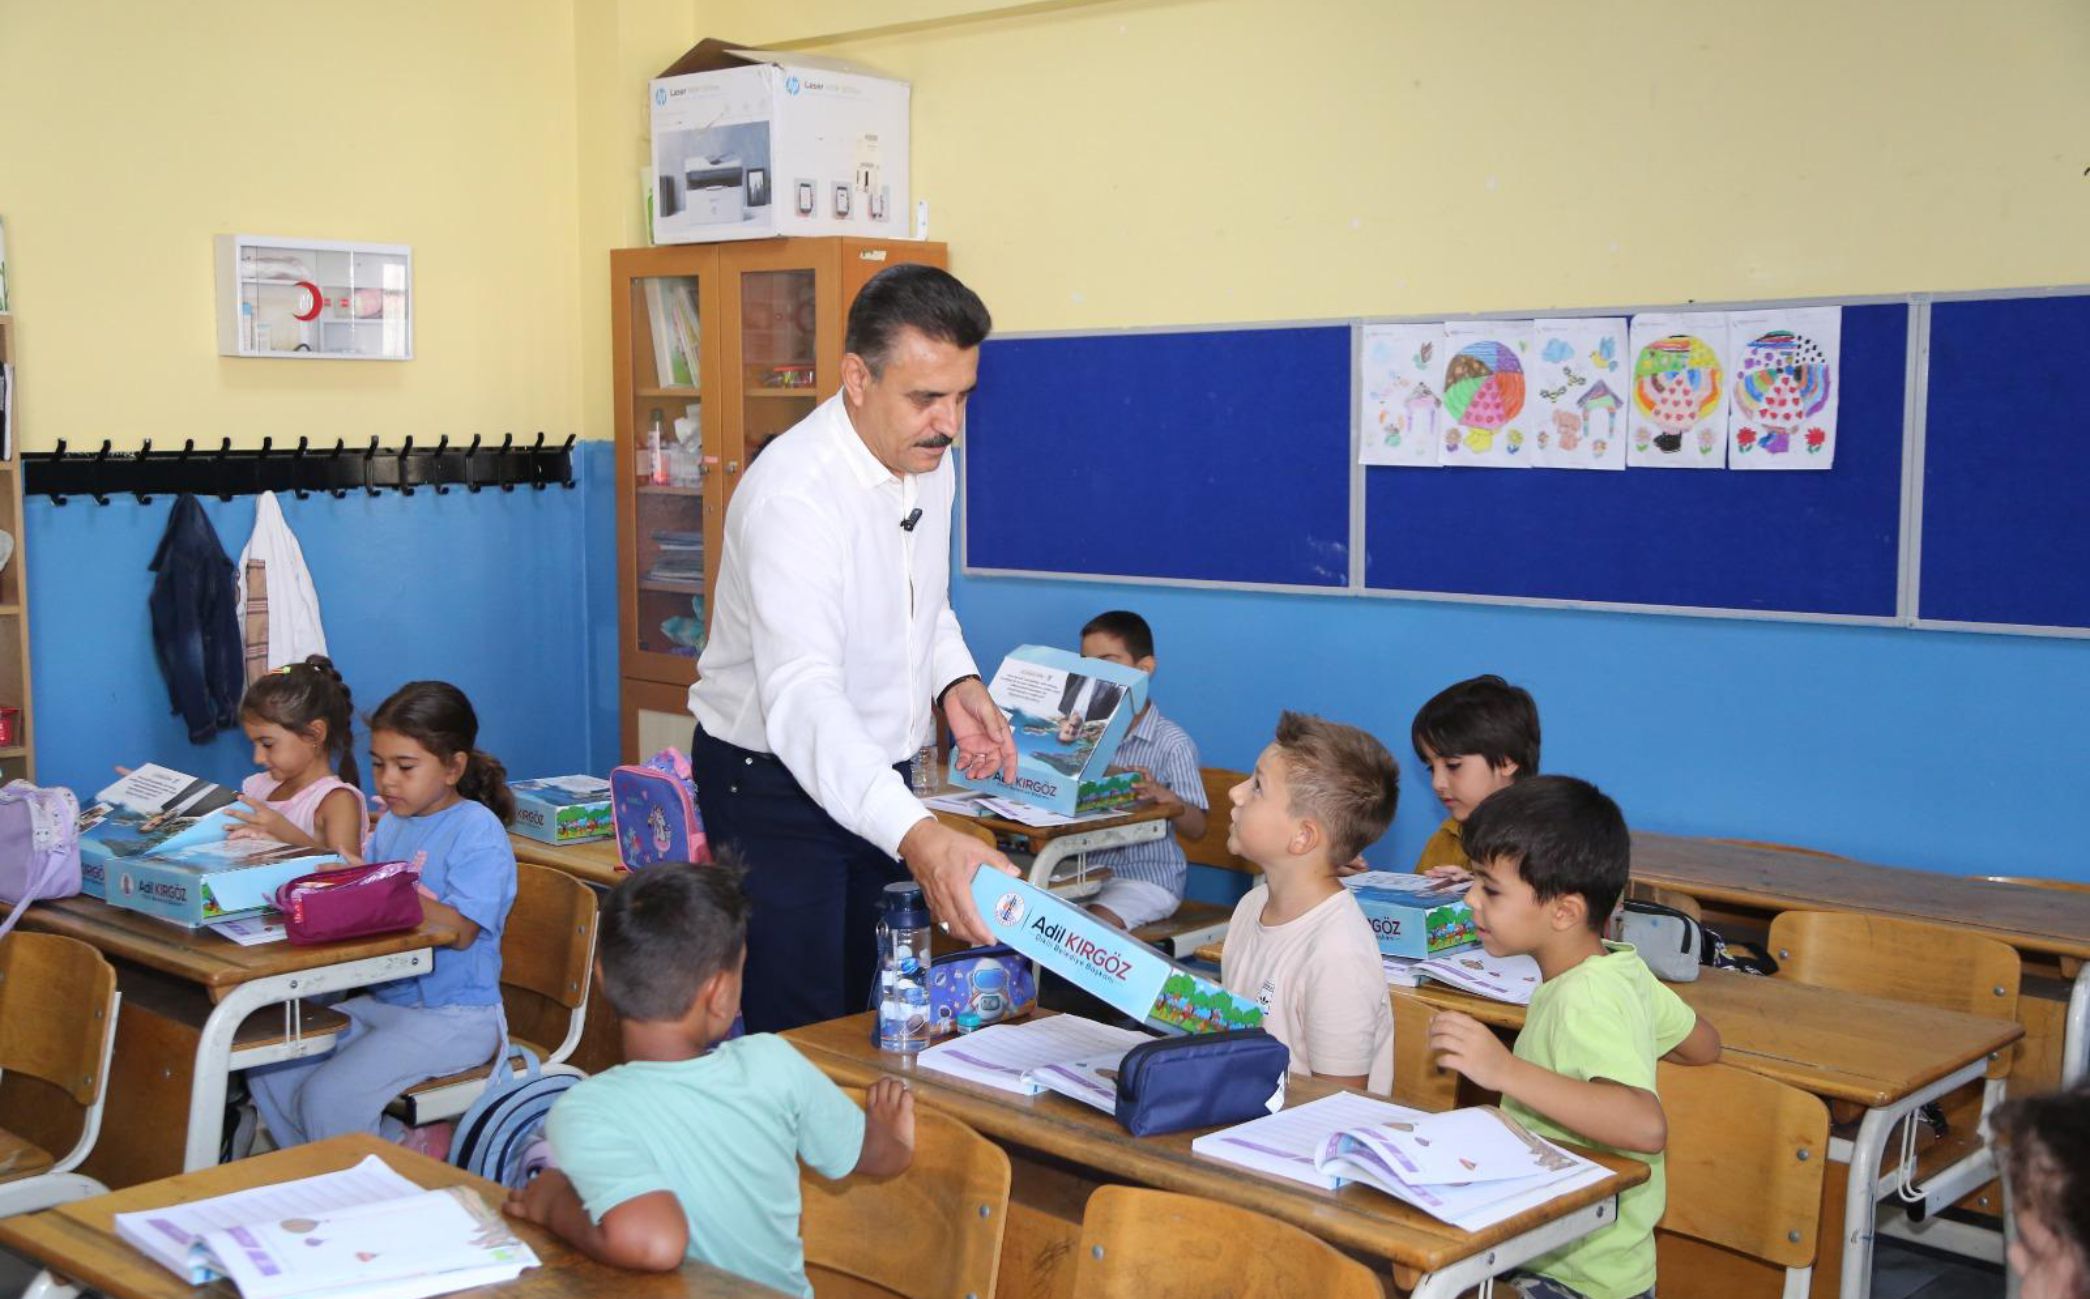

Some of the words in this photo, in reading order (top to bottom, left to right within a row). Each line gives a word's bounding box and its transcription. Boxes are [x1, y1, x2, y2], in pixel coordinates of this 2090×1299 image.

[670, 88, 687, 97] Laser
[804, 80, 824, 90] Laser
[1016, 776, 1058, 797] KIRGÖZ
[139, 880, 154, 894] Adil
[154, 883, 187, 902] KIRGÖZ
[1367, 916, 1401, 935] GÖZ
[1031, 916, 1067, 944] Adil
[1065, 932, 1132, 981] KIRGÖZ
[1053, 944, 1084, 966] Belediye
